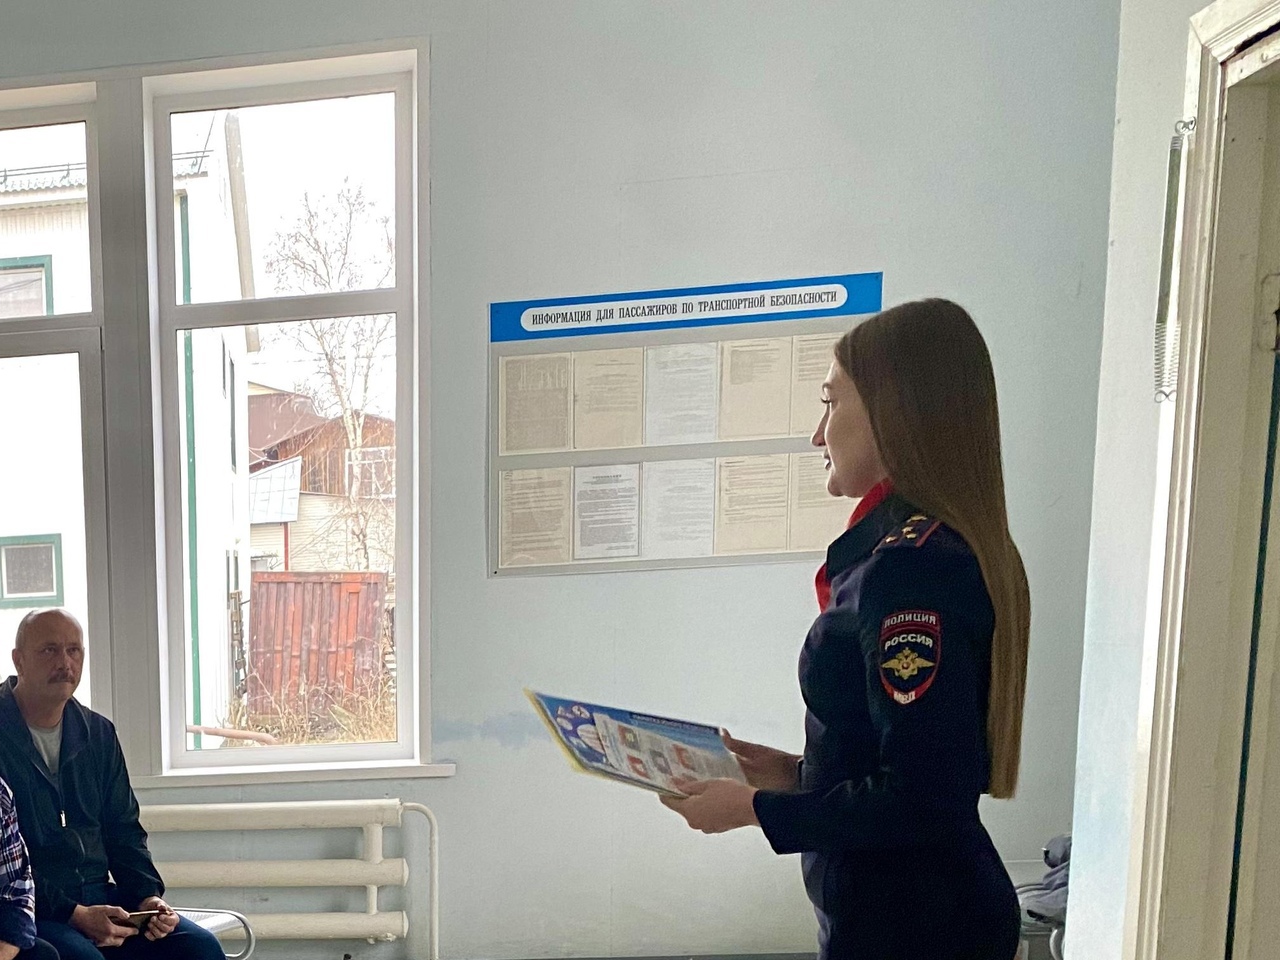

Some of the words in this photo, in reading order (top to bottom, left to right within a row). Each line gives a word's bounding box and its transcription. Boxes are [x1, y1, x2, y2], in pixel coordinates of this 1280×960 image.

[532, 310, 592, 325] ИНФОРМАЦИЯ
[596, 308, 614, 322] ДЛЯ
[619, 303, 677, 318] ПАССАЖИРОВ
[682, 302, 693, 314] ПО
[698, 294, 765, 312] ТРАНСПОРТНОЙ
[770, 291, 837, 307] БЕЗОПАСНОСТИ
[884, 613, 936, 628] ПОЛИЦИЯ
[884, 633, 933, 651] РОССИЯ
